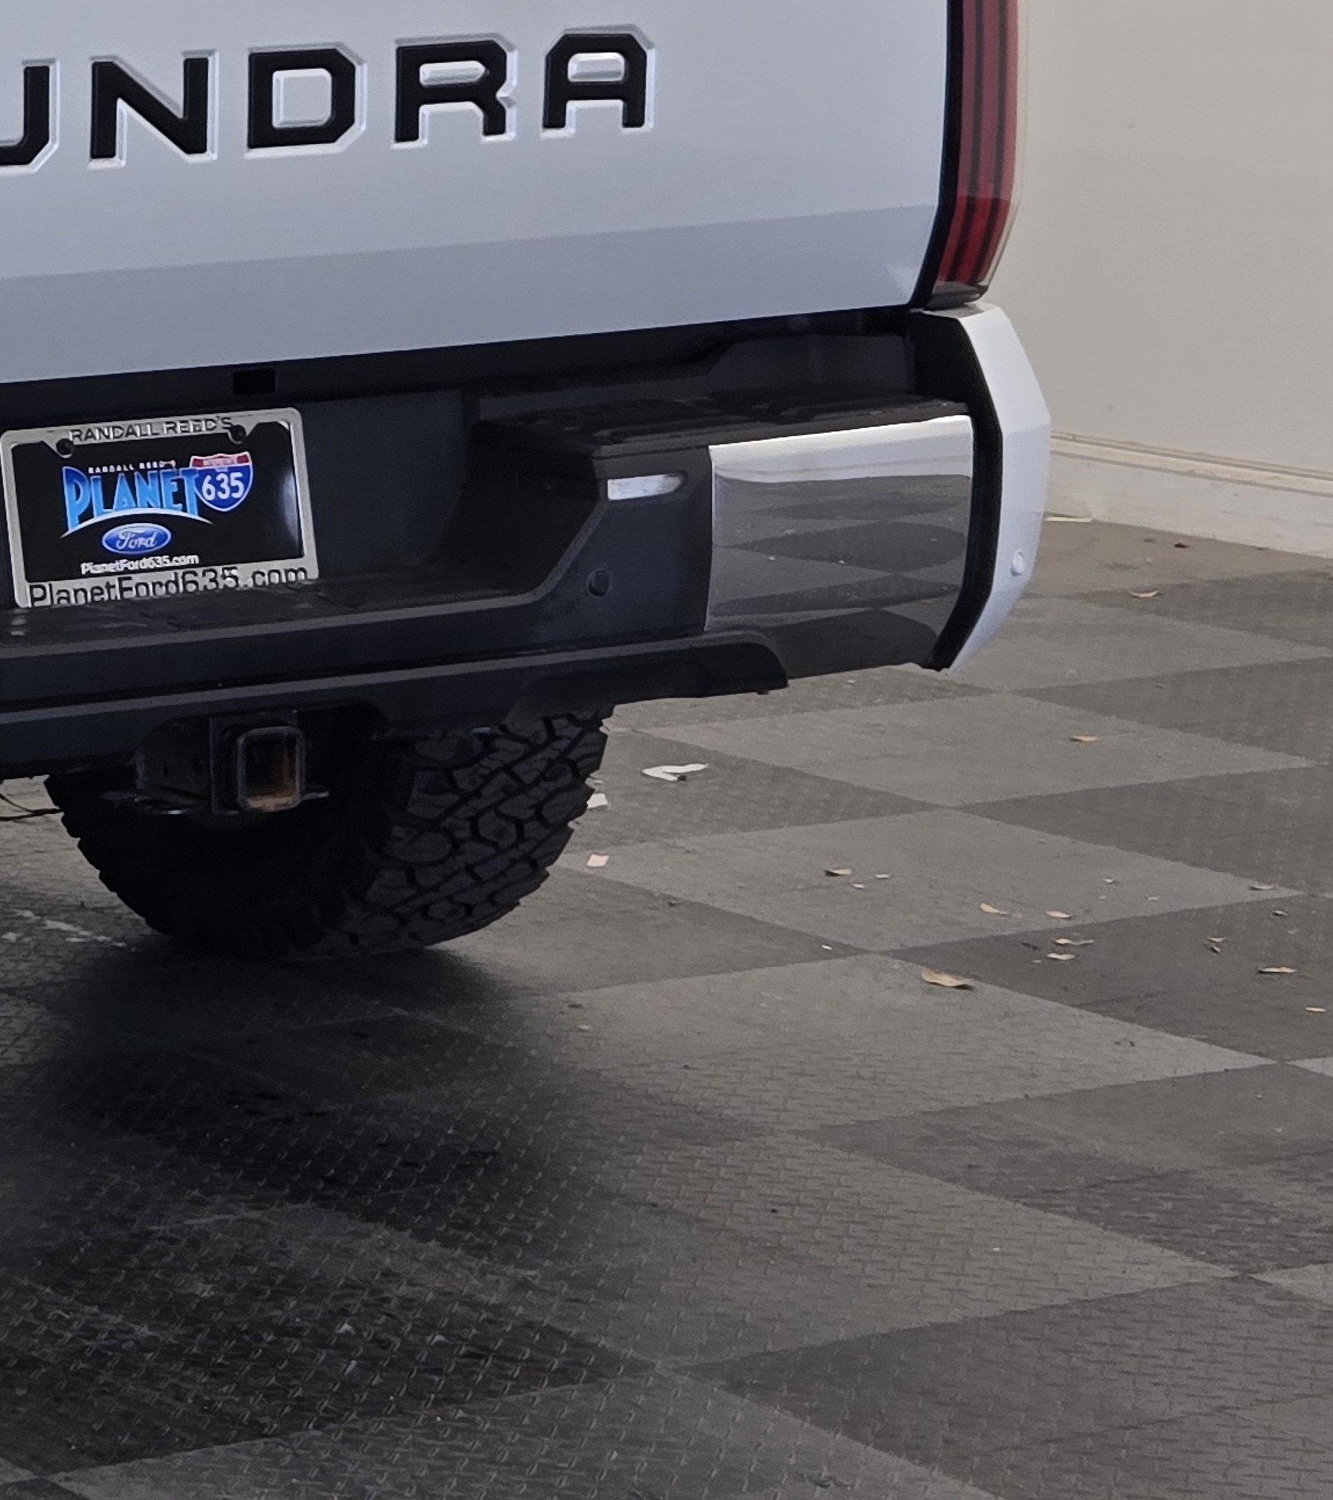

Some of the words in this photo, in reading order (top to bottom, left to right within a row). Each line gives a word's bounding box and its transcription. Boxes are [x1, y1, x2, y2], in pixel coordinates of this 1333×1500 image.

[69, 422, 160, 442] RANDALL
[163, 415, 233, 434] REED'S
[62, 465, 200, 532] PLANET
[201, 472, 245, 501] 635
[115, 526, 158, 551] Ford
[81, 554, 200, 576] PlanetFord635.com
[29, 566, 309, 607] PlanetFord635.com
